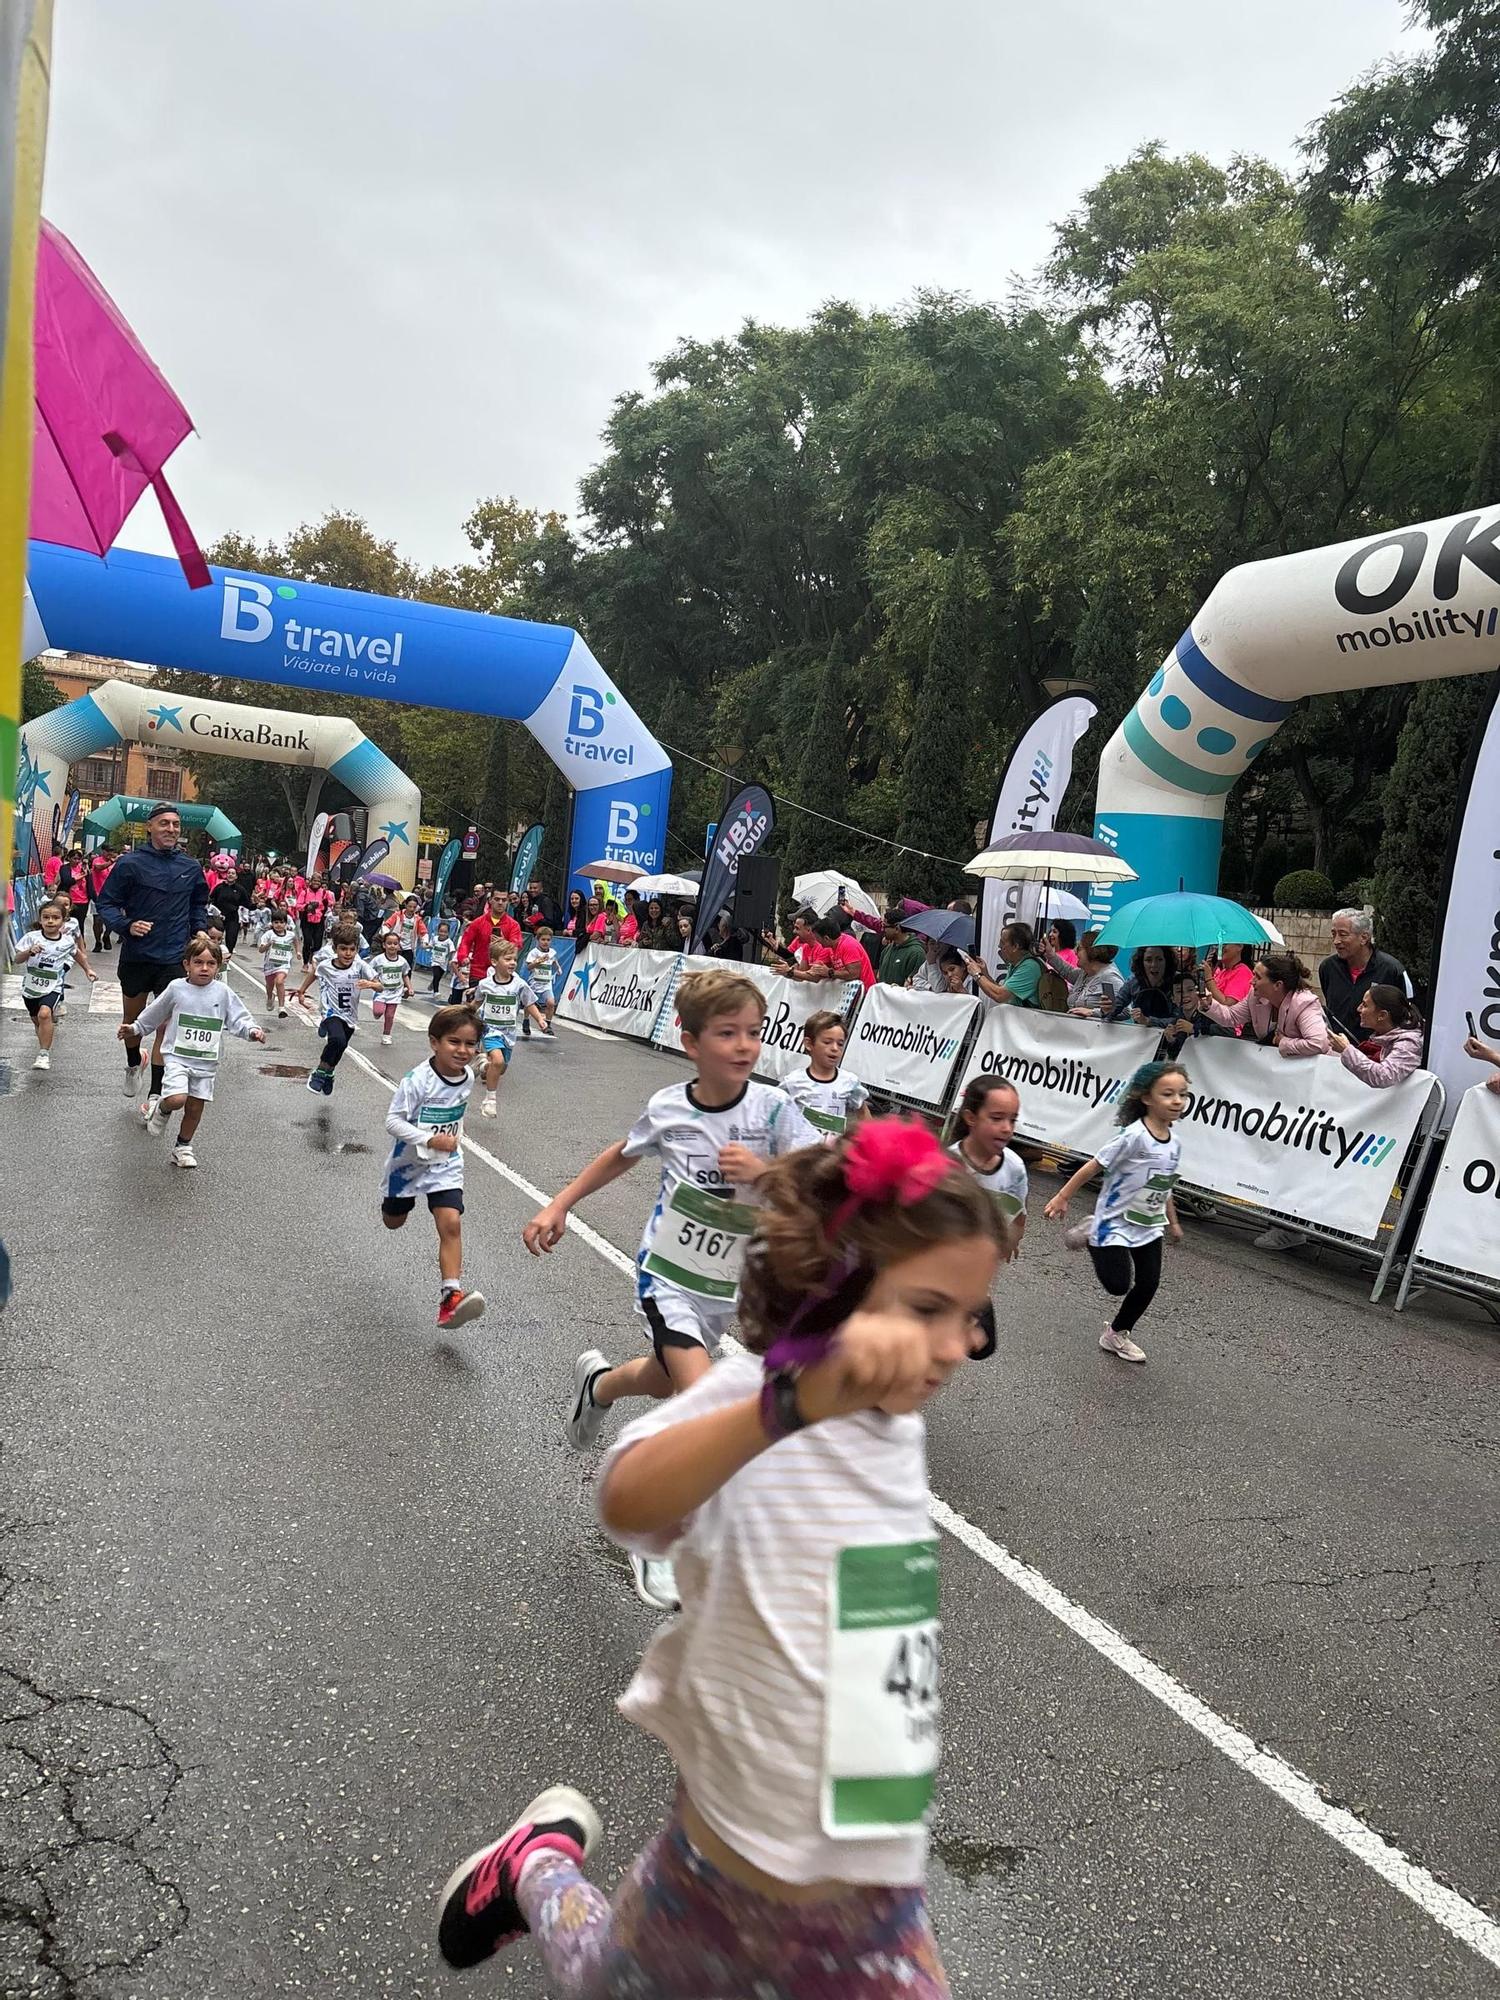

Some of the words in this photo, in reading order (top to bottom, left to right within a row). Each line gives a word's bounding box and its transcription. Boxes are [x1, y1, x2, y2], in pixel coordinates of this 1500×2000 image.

[1334, 515, 1500, 616] OK
[220, 576, 274, 643] B
[284, 618, 403, 666] travel
[1336, 607, 1485, 653] mobility
[283, 654, 341, 676] Viájate
[345, 664, 358, 678] la
[363, 668, 397, 684] vida
[567, 684, 605, 738] B
[189, 713, 310, 751] CaixaBank
[564, 736, 634, 766] travel
[607, 800, 639, 845] B
[360, 847, 388, 870] Trablisa
[604, 844, 657, 867] travel
[589, 967, 661, 1012] CaixaBank
[490, 1004, 511, 1015] 5219
[184, 1028, 212, 1043] 5180
[678, 1220, 738, 1260] 5167
